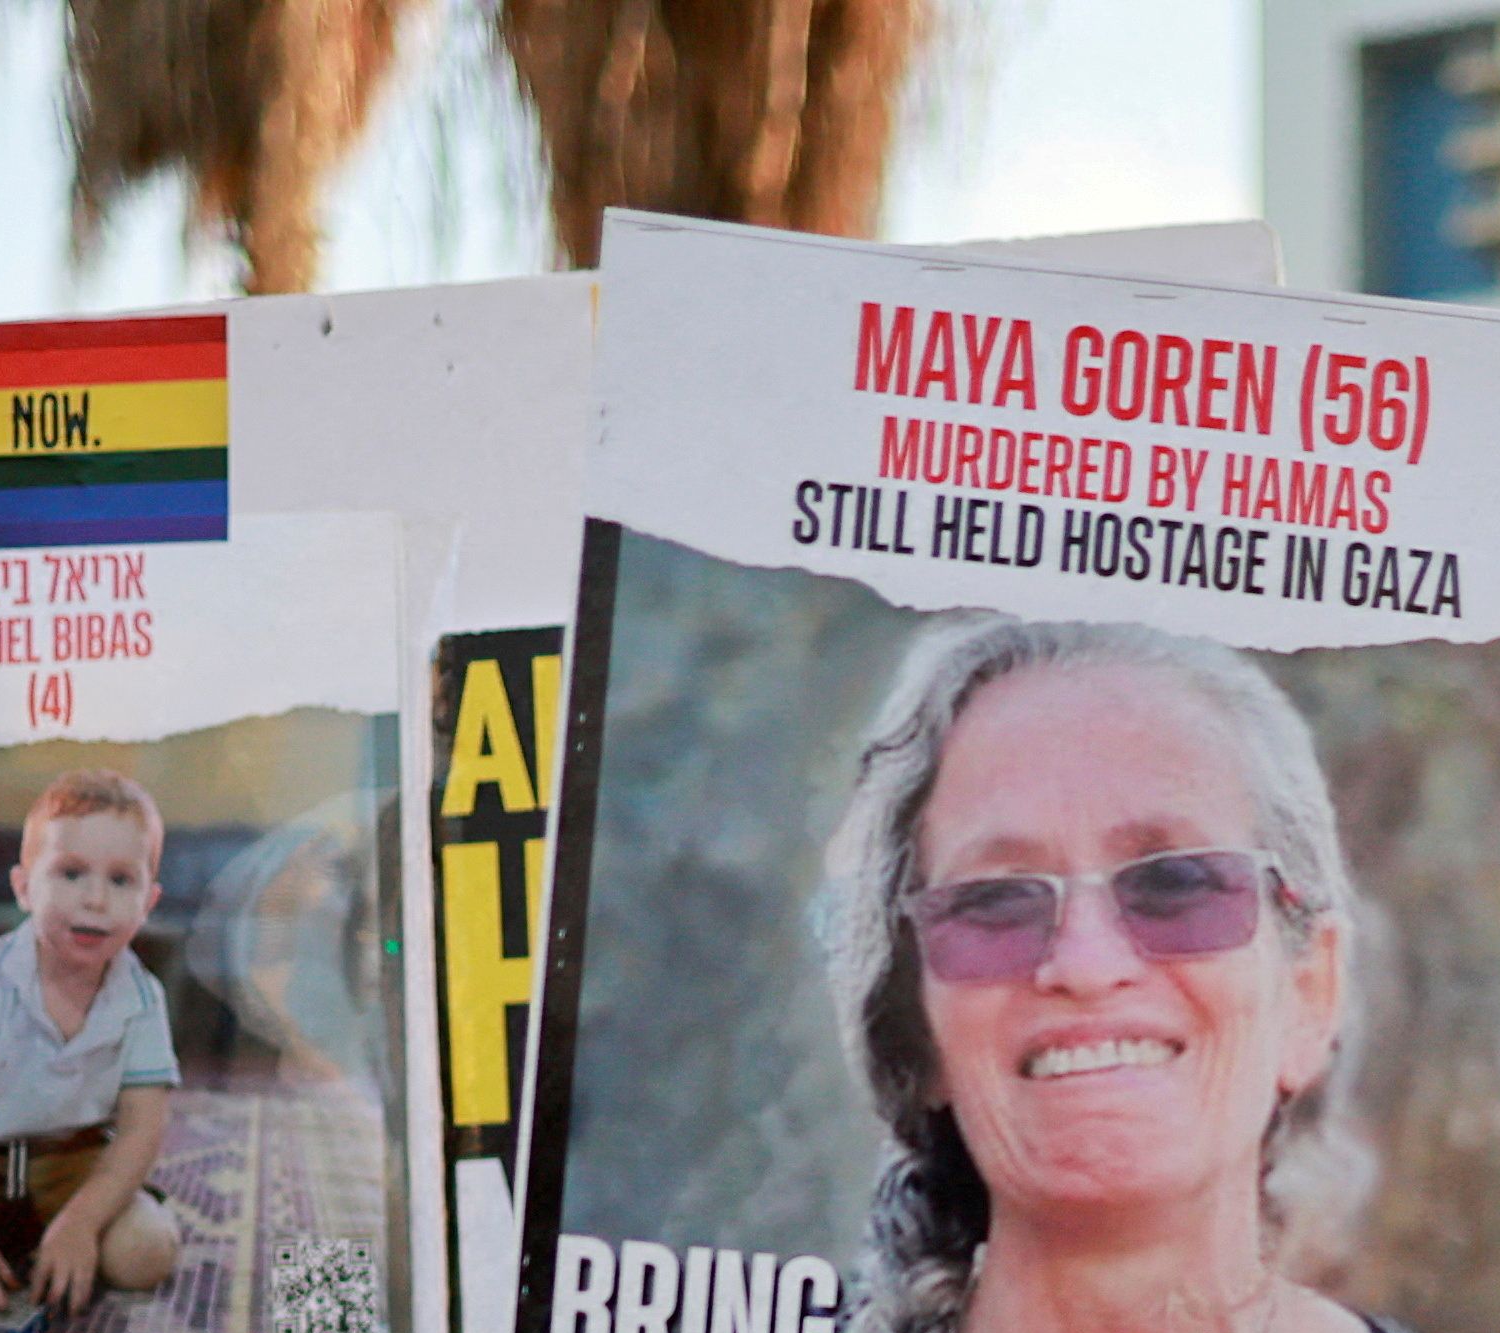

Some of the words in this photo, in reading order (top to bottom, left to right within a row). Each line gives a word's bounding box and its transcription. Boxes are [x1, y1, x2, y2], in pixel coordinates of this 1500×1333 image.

[853, 299, 1038, 413] MAYA
[1060, 322, 1278, 436] GOREN
[1301, 342, 1431, 466] (56)
[10, 391, 103, 452] NOW.
[877, 415, 1133, 508] MURDERED
[1146, 447, 1210, 515] BY
[1220, 454, 1392, 535] HAMAS
[43, 551, 145, 603] אריאל
[792, 479, 916, 558] STILL
[932, 494, 1046, 569] HELD
[1060, 507, 1271, 596] HOSTAGE
[1281, 533, 1327, 601] IN
[1341, 540, 1464, 620] GAZA
[54, 611, 153, 661] BIBAS
[29, 670, 72, 727] (4)
